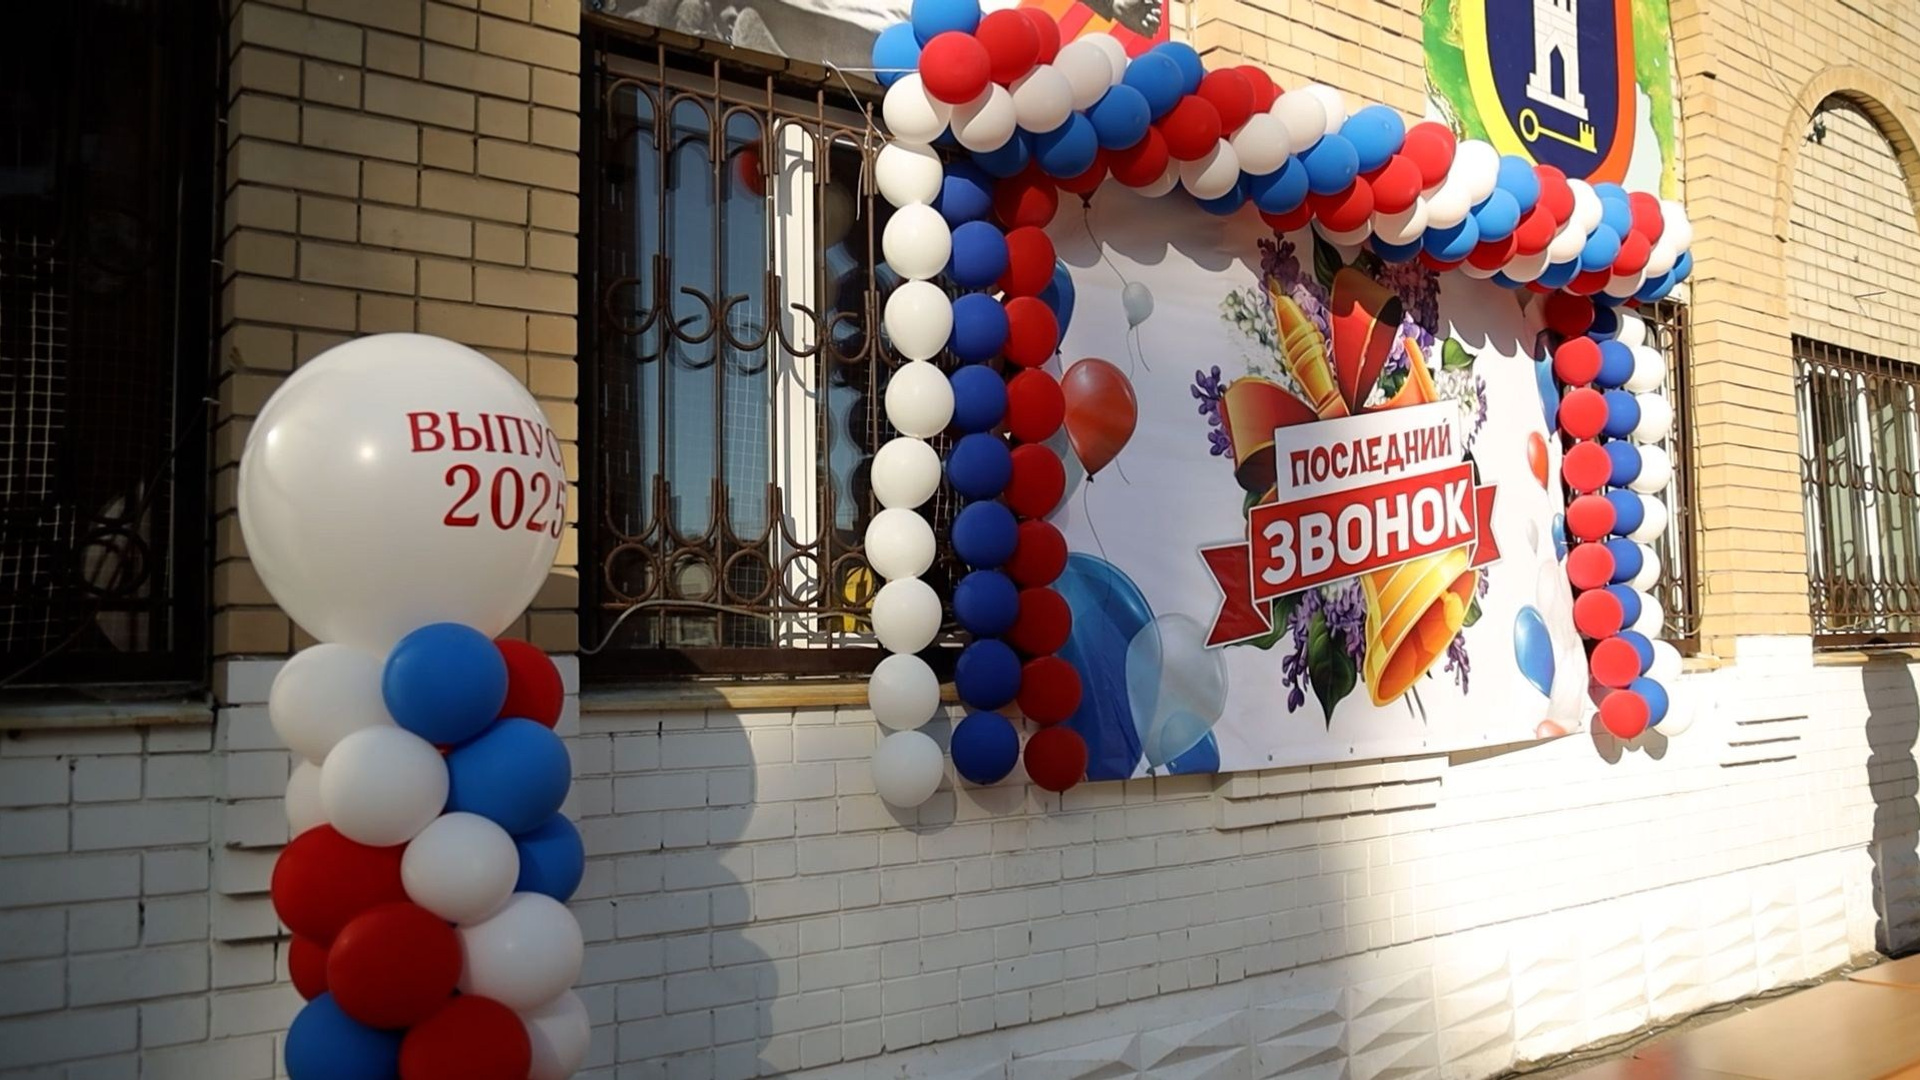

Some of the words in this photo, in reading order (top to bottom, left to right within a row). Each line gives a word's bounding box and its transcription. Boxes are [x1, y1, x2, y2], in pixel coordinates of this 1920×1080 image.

[406, 411, 564, 469] ВЫПУС
[1290, 419, 1453, 487] ПОСЛЕДНИЙ
[443, 463, 566, 539] 2025
[1261, 479, 1472, 584] ЗВОНОК
